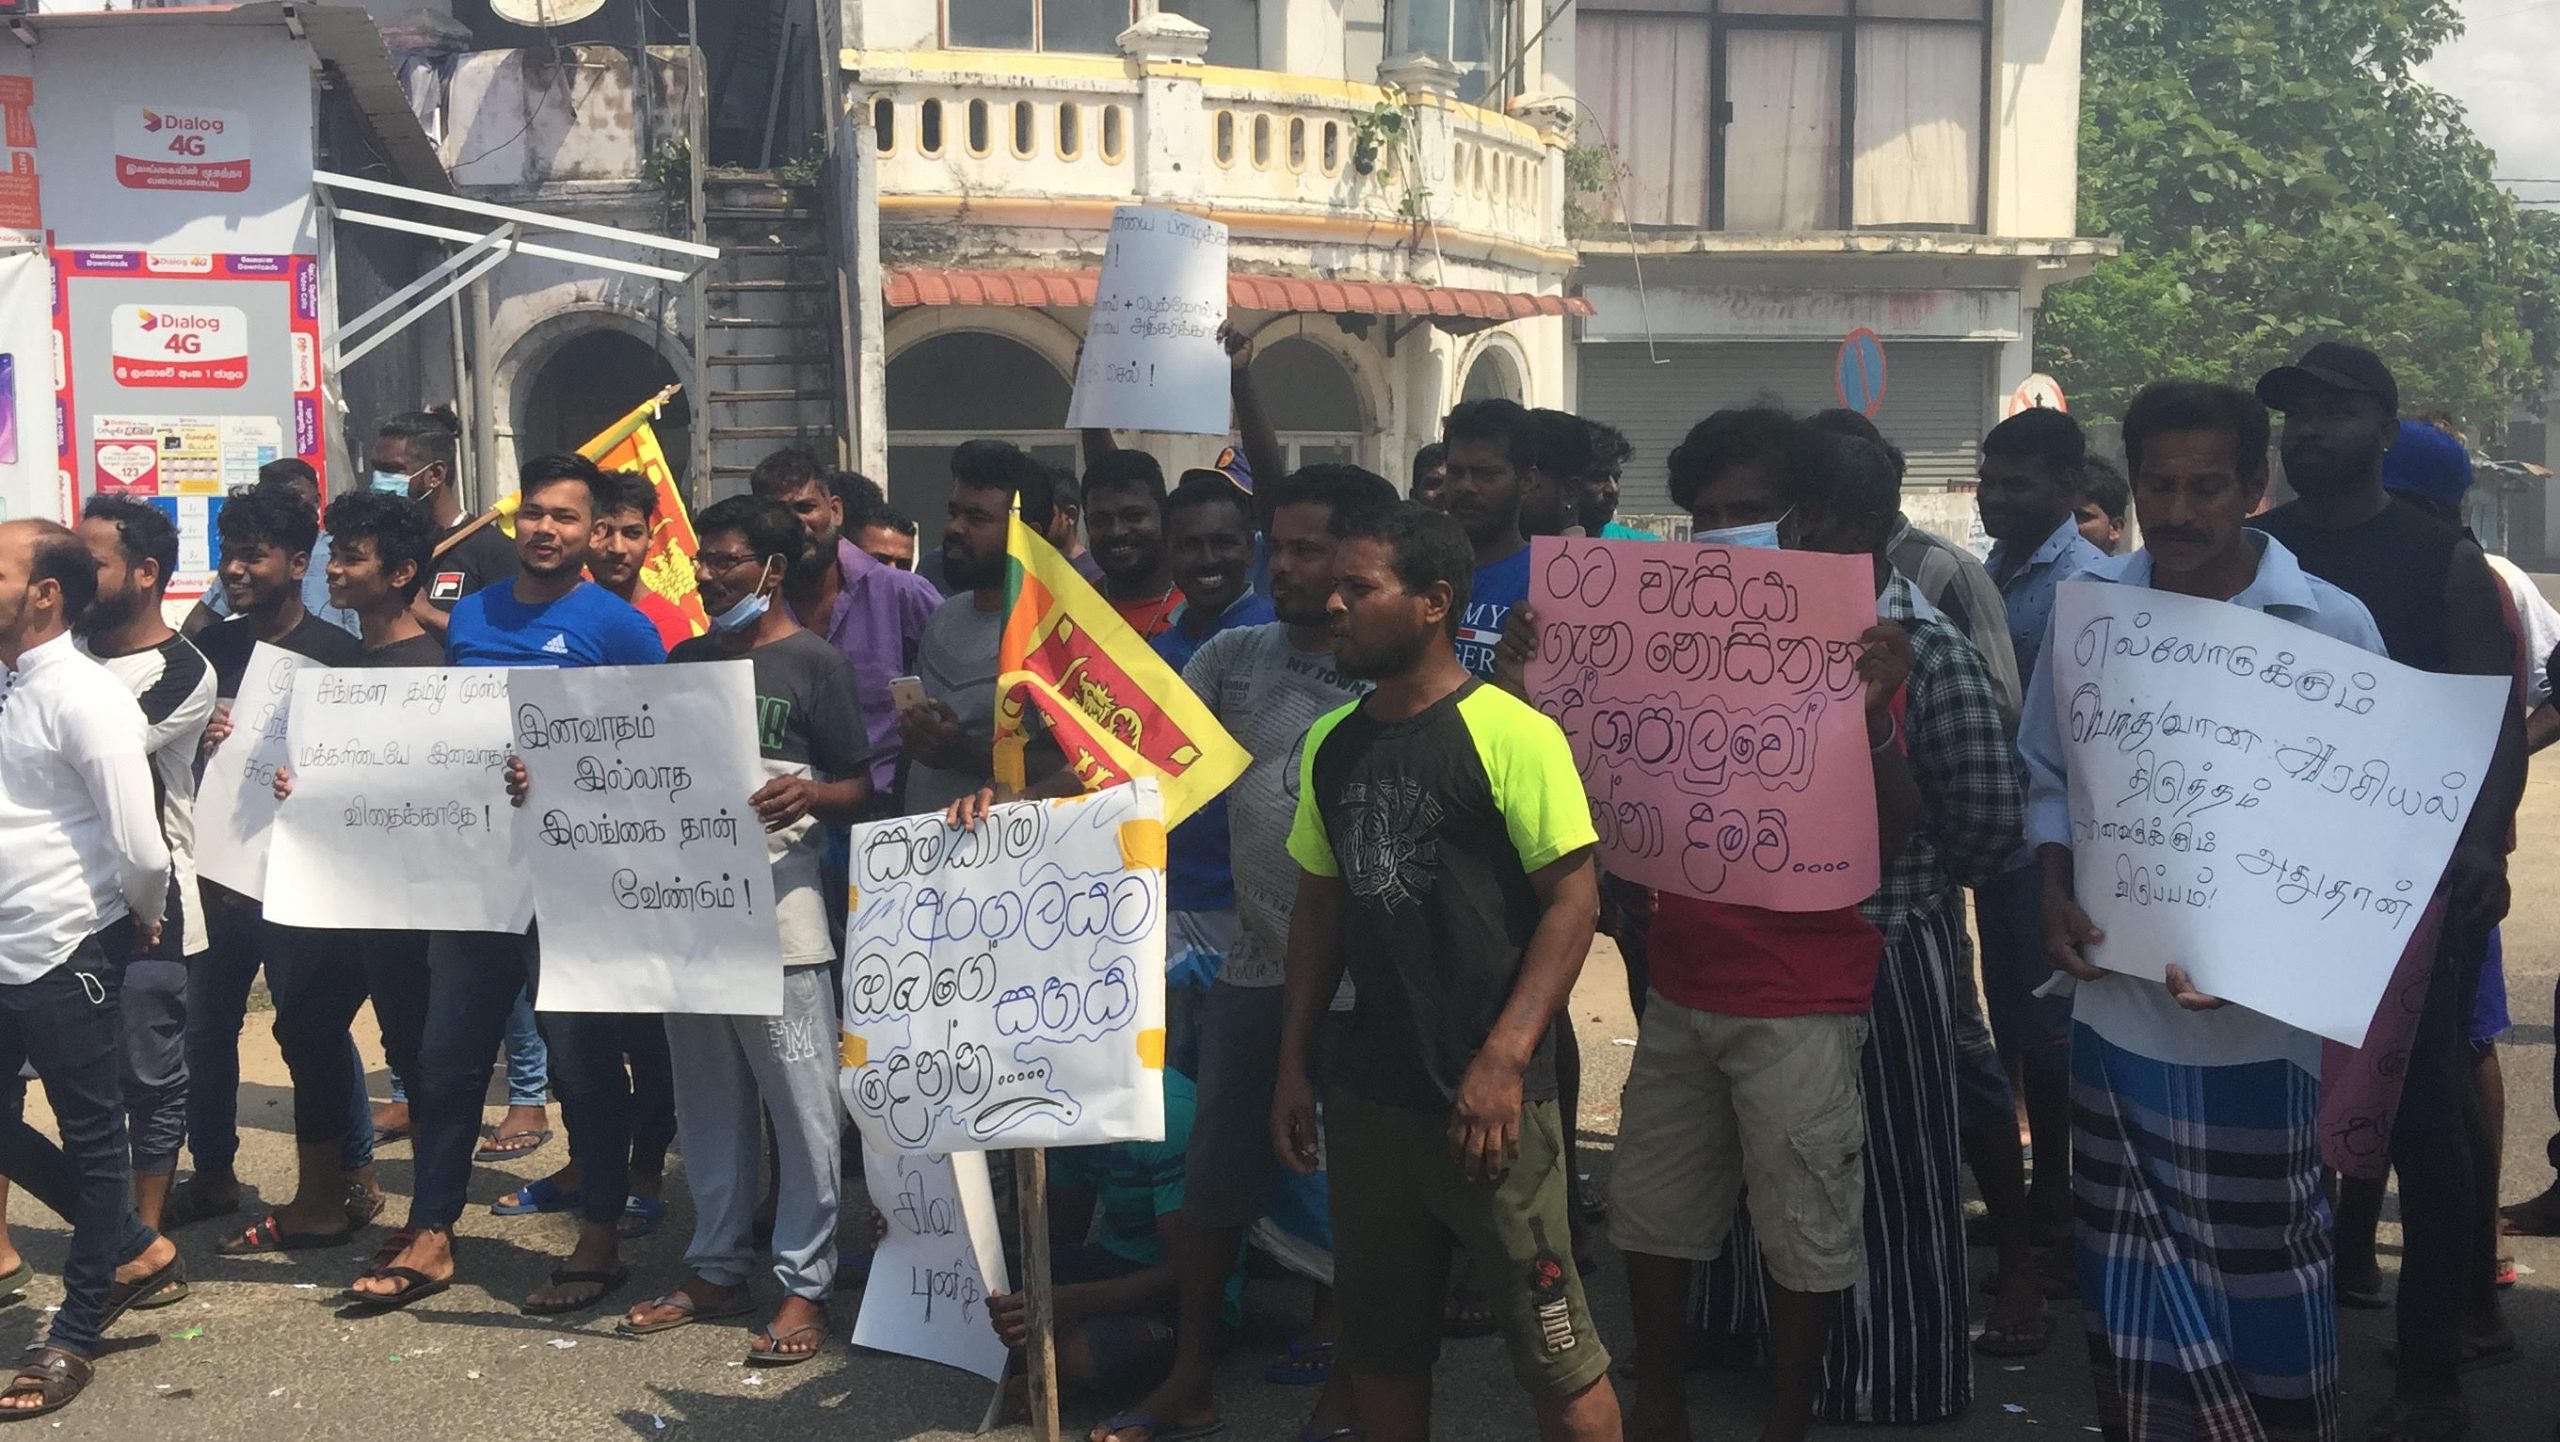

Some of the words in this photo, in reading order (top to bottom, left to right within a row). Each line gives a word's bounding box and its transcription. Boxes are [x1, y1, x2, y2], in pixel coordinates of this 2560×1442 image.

[165, 115, 224, 134] Dialog
[168, 135, 205, 156] 4G
[160, 257, 188, 268] Dialog
[237, 263, 278, 271] Downloads
[300, 292, 308, 310] Calls
[161, 314, 220, 332] Dialog
[164, 333, 201, 354] 4G
[206, 369, 211, 378] 1
[305, 407, 313, 424] Calls
[305, 425, 314, 445] Video
[122, 468, 139, 477] 123
[1546, 541, 1616, 607] රට
[1461, 602, 1510, 630] MY
[1542, 621, 1634, 684] ගැන
[1286, 656, 1314, 676] NY
[1315, 667, 1369, 697] TOWN
[316, 673, 388, 705] சிங்கள
[403, 673, 449, 715] தமிழ்
[518, 703, 656, 750] இனவாதம்
[574, 755, 692, 803] இல்லாத
[539, 808, 666, 850] இலங்கை
[680, 807, 737, 850] தான்
[907, 876, 1151, 959] අරගලයට
[853, 938, 998, 1015] ඔබගේ
